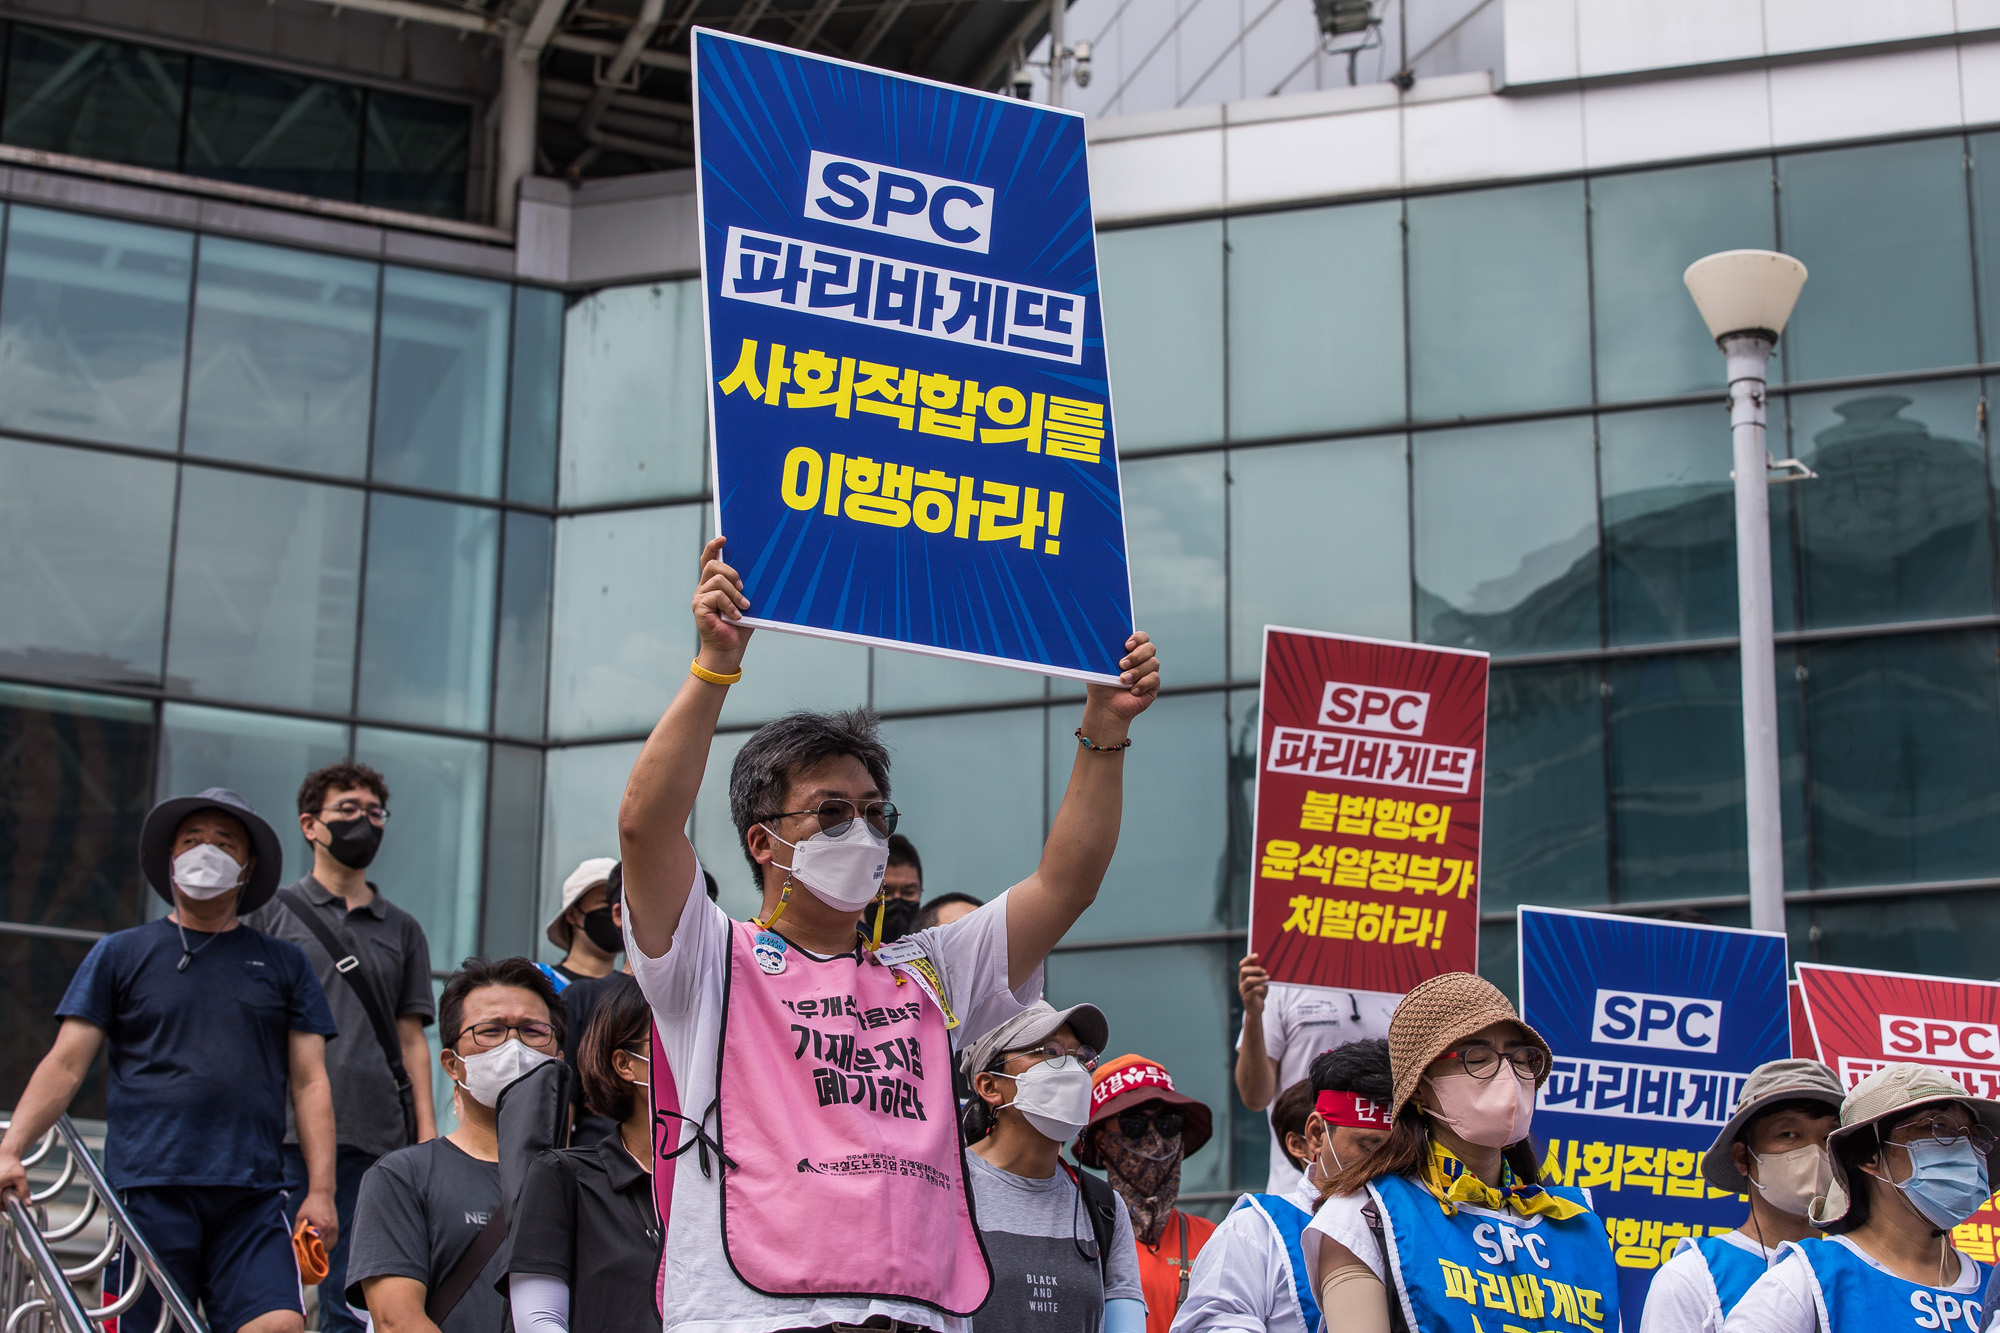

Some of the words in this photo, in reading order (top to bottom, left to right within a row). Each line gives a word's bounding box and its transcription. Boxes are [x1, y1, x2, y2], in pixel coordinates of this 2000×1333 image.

[815, 161, 984, 244] SPC
[732, 234, 1074, 358] 파리바게뜨
[719, 338, 1105, 463] 사회적합의를
[781, 446, 1065, 556] 이행하라!
[1326, 687, 1422, 730] SPC
[1275, 732, 1468, 788] 파리바게뜨
[1300, 790, 1452, 844] 불법행위
[1282, 894, 1448, 950] 처벌하라!
[1600, 996, 1714, 1047] SPC
[1889, 1020, 1994, 1060] SPC
[813, 1067, 928, 1121] 폐기하라
[1093, 1072, 1125, 1104] 단결
[1544, 1060, 1738, 1122] 파리바게
[1539, 1139, 1749, 1203] 사회적합
[464, 1211, 493, 1225] NE
[1472, 1222, 1550, 1269] SPC
[1026, 1274, 1058, 1286] BLACK
[1029, 1301, 1058, 1313] WHITE
[1033, 1287, 1052, 1298] AND
[1438, 1258, 1605, 1333] 파리바게뜨
